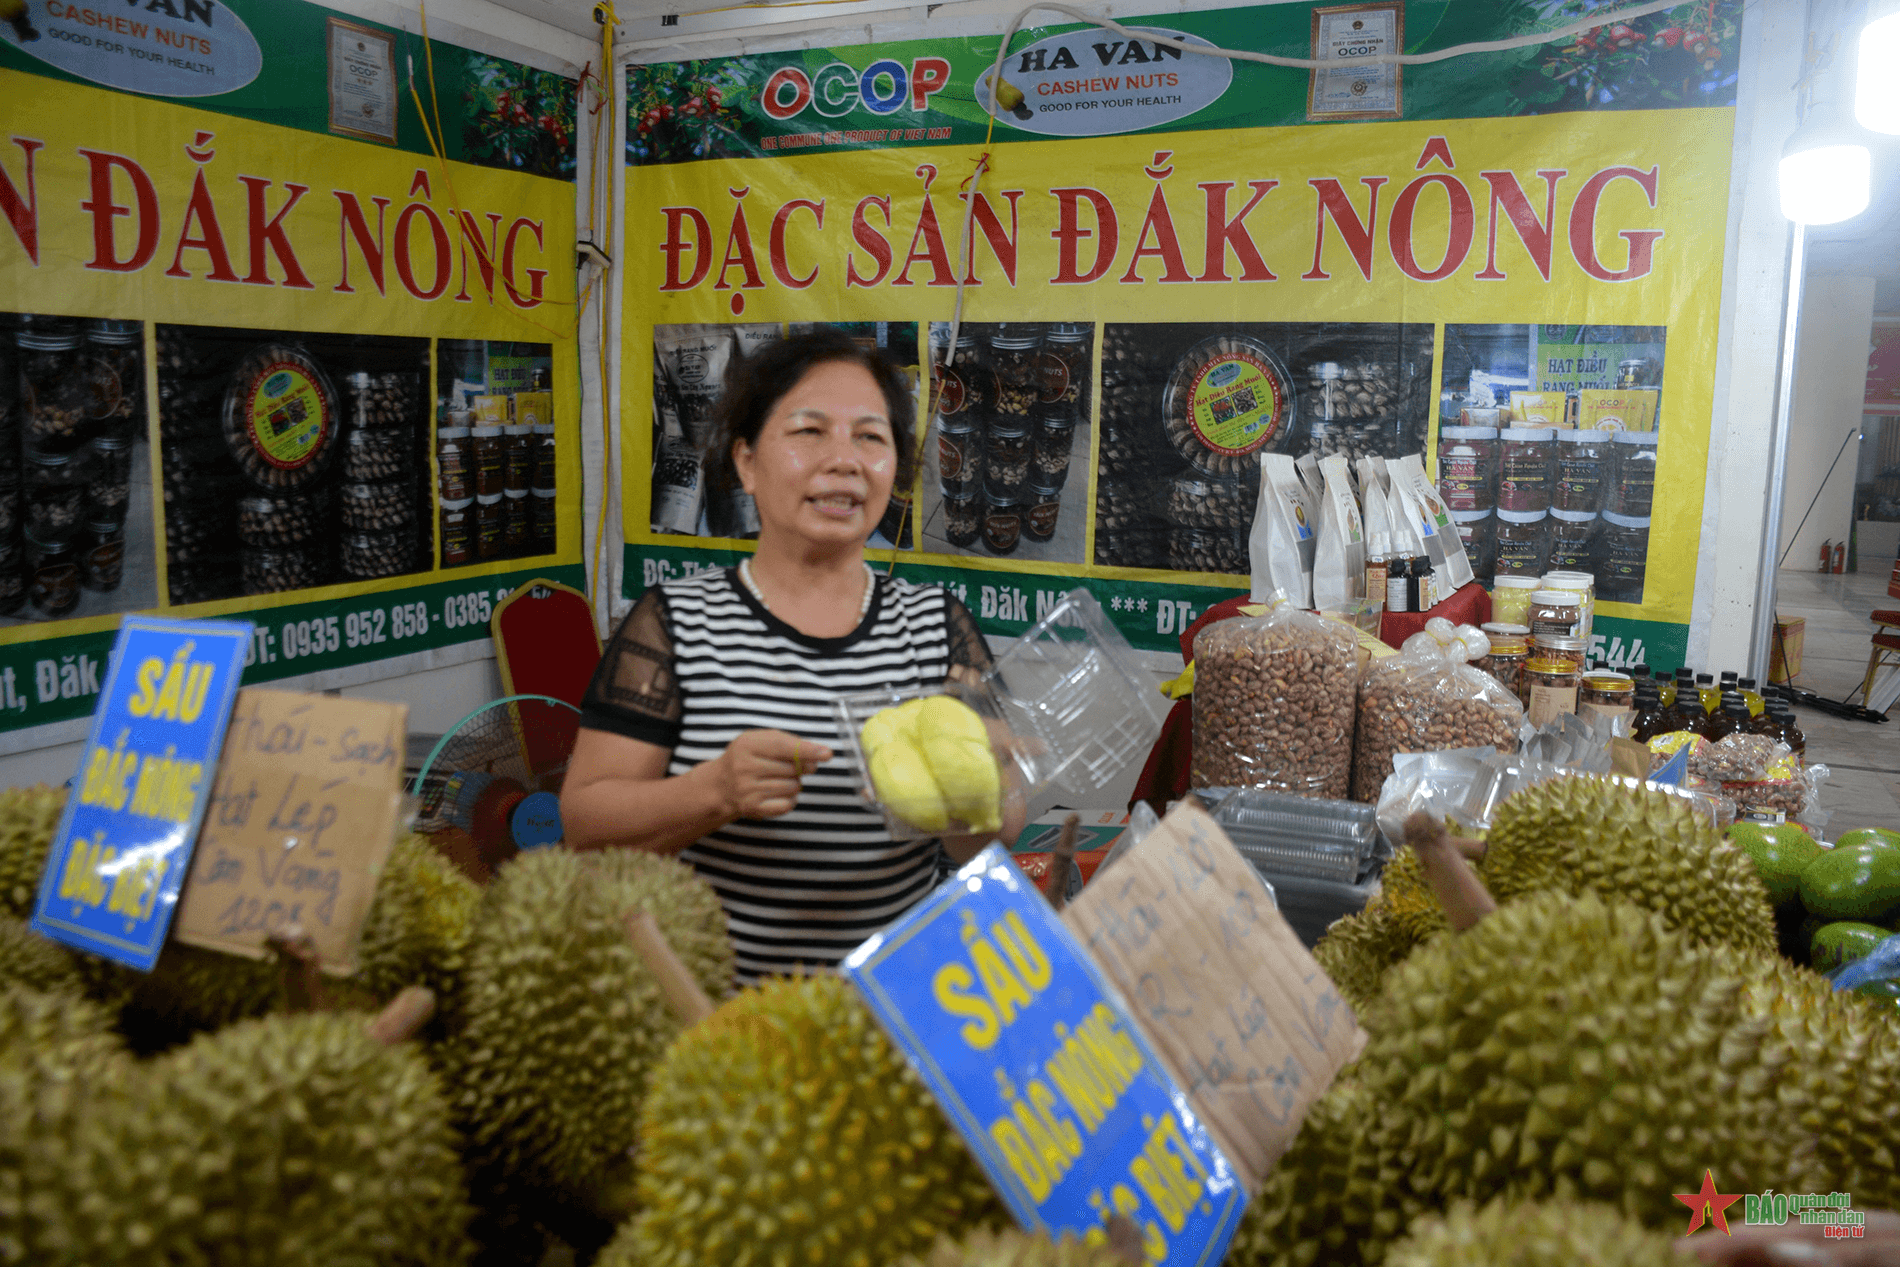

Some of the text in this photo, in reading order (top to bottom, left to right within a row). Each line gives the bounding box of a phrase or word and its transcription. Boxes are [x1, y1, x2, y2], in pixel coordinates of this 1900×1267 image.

[46, 0, 211, 55] CASHEW NUTS
[48, 27, 215, 76] GOOD FOR YOUR HEALTH
[1338, 46, 1377, 56] OCOP
[1018, 36, 1186, 73] HA VAN
[762, 56, 951, 120] OCOP
[1037, 72, 1179, 97] CASHEW NUTS
[1039, 95, 1182, 112] GOOD FOR YOUR HEALTH
[761, 126, 952, 150] ONE COMMUNE ONE PRODUCT OF VIET NAM
[77, 130, 315, 291] ĐẮK
[332, 168, 549, 309] NÔNG
[658, 136, 1665, 317] ĐẶC SẢN ĐẮK NÔNG
[282, 616, 340, 660] 0935
[345, 608, 387, 648] 952
[391, 601, 430, 640] 858
[444, 591, 492, 629] 0385
[981, 585, 1028, 623] Đăk
[36, 654, 100, 703] Đăk
